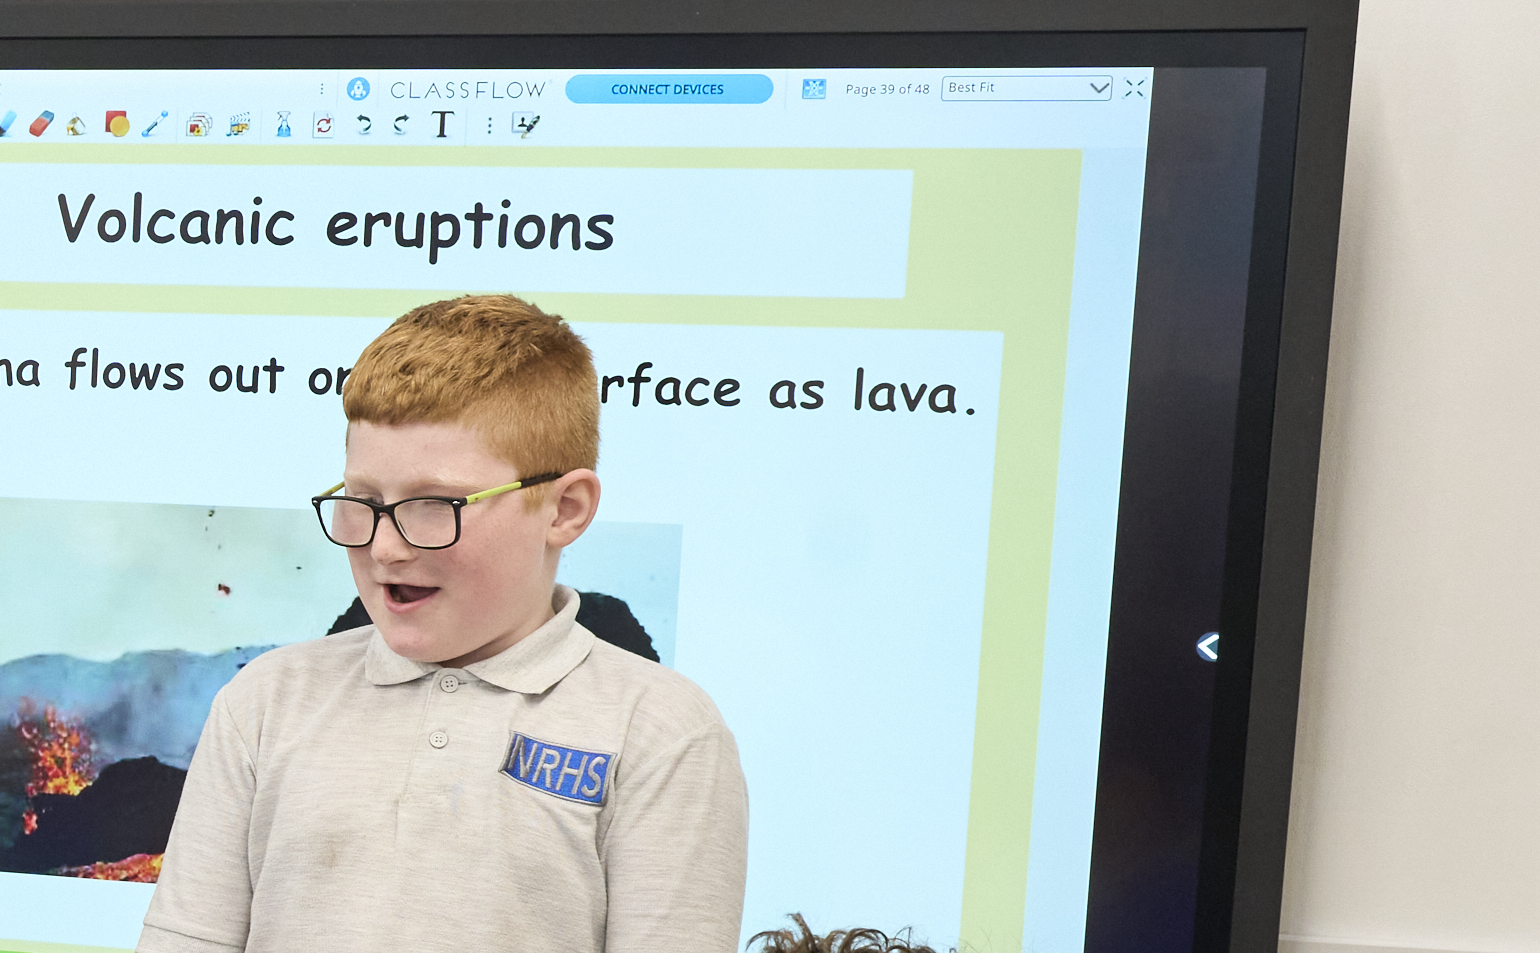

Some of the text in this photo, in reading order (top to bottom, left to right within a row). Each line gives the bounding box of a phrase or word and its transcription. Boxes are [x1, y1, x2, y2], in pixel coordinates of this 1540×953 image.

[390, 81, 547, 99] CLASSFLOW
[611, 83, 724, 95] CONNECT DEVICES
[845, 83, 930, 97] Page 39 of 48
[948, 82, 995, 93] Best Fit
[57, 192, 615, 265] Volcanic eruptions
[65, 347, 185, 391] flows
[208, 356, 285, 394] out
[600, 362, 741, 407] rface
[769, 379, 824, 410] as
[855, 367, 976, 415] lava.
[507, 735, 607, 799] NRHS
